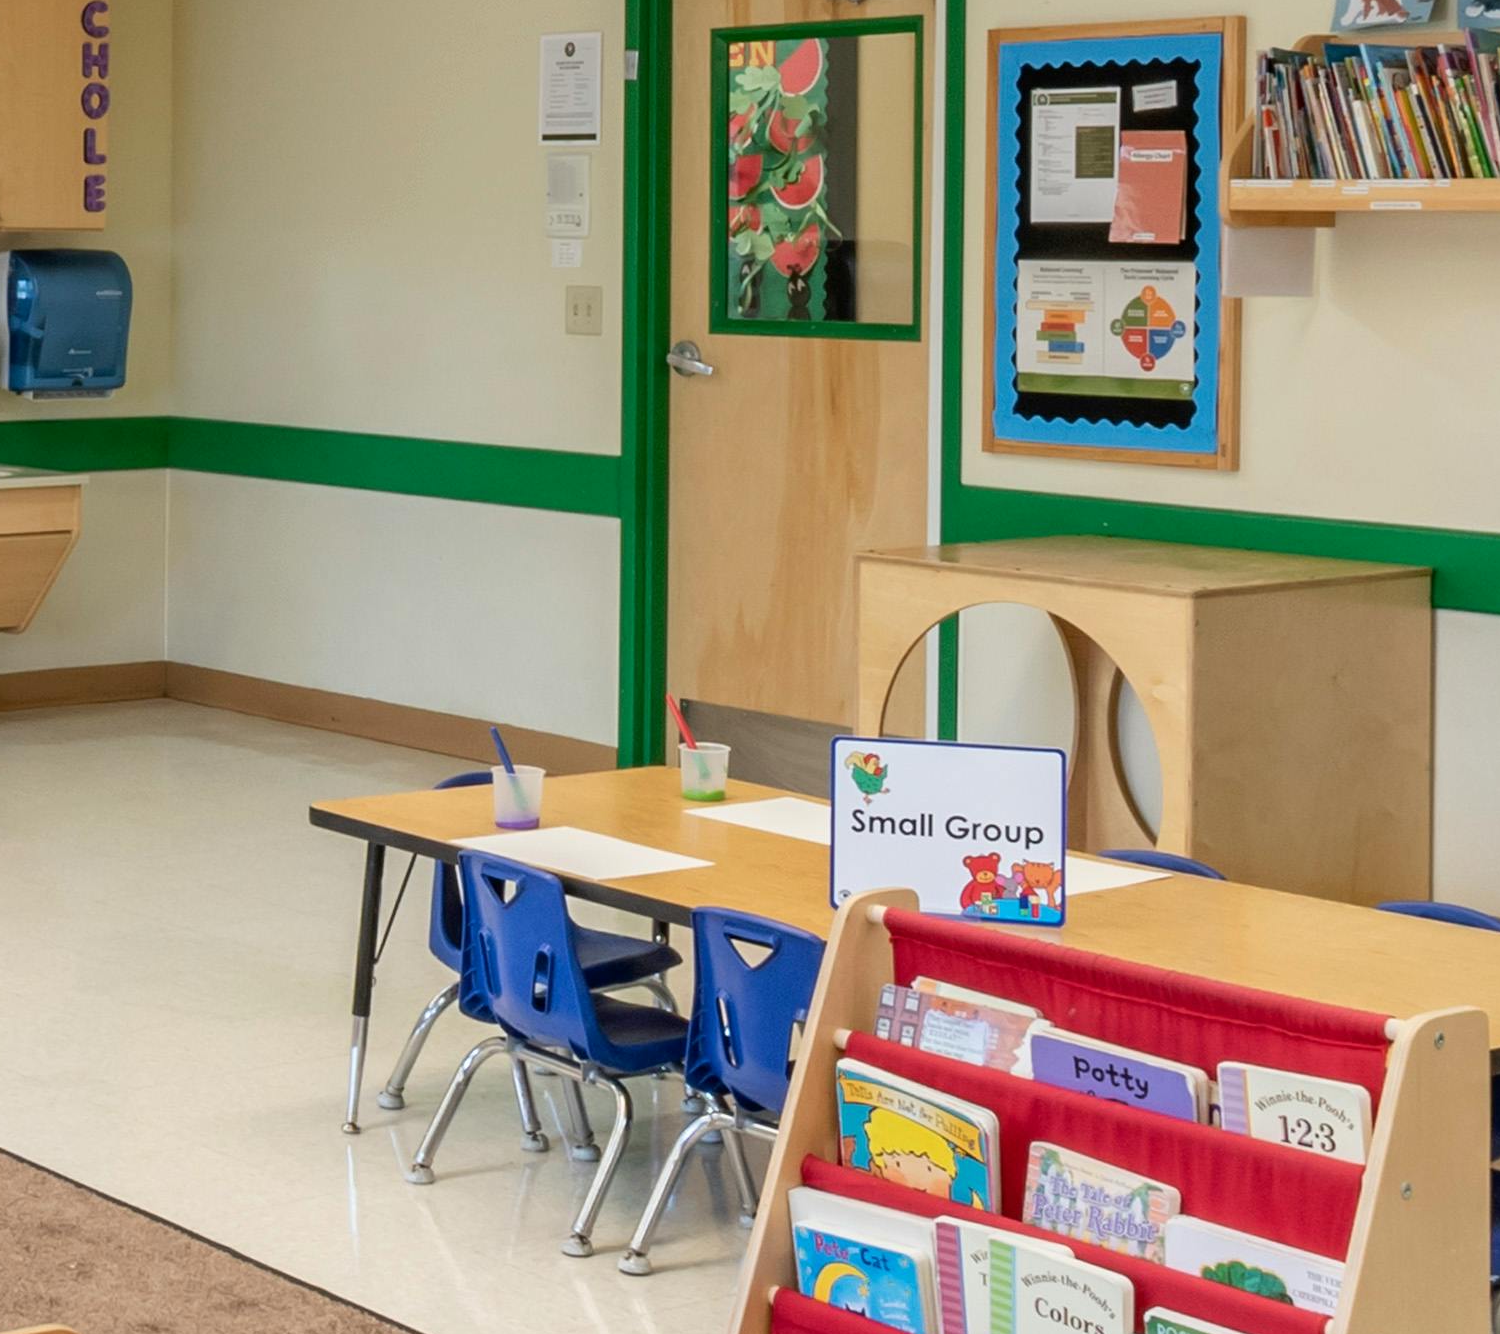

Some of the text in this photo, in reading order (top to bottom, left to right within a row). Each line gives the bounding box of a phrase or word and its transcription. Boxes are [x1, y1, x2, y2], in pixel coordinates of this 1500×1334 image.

[850, 808, 1045, 850] Small Group
[1073, 1055, 1149, 1100] Potty
[876, 1090, 895, 1108] Are
[896, 1098, 917, 1117] Not
[1254, 1089, 1355, 1132] Winnie-the-Pooh's
[1050, 1173, 1134, 1212] The Tale of
[1032, 1192, 1159, 1243] Peter Rabbit
[813, 1232, 891, 1272] Pete Cat
[1020, 1270, 1117, 1321] Winnie-the-Pooh's
